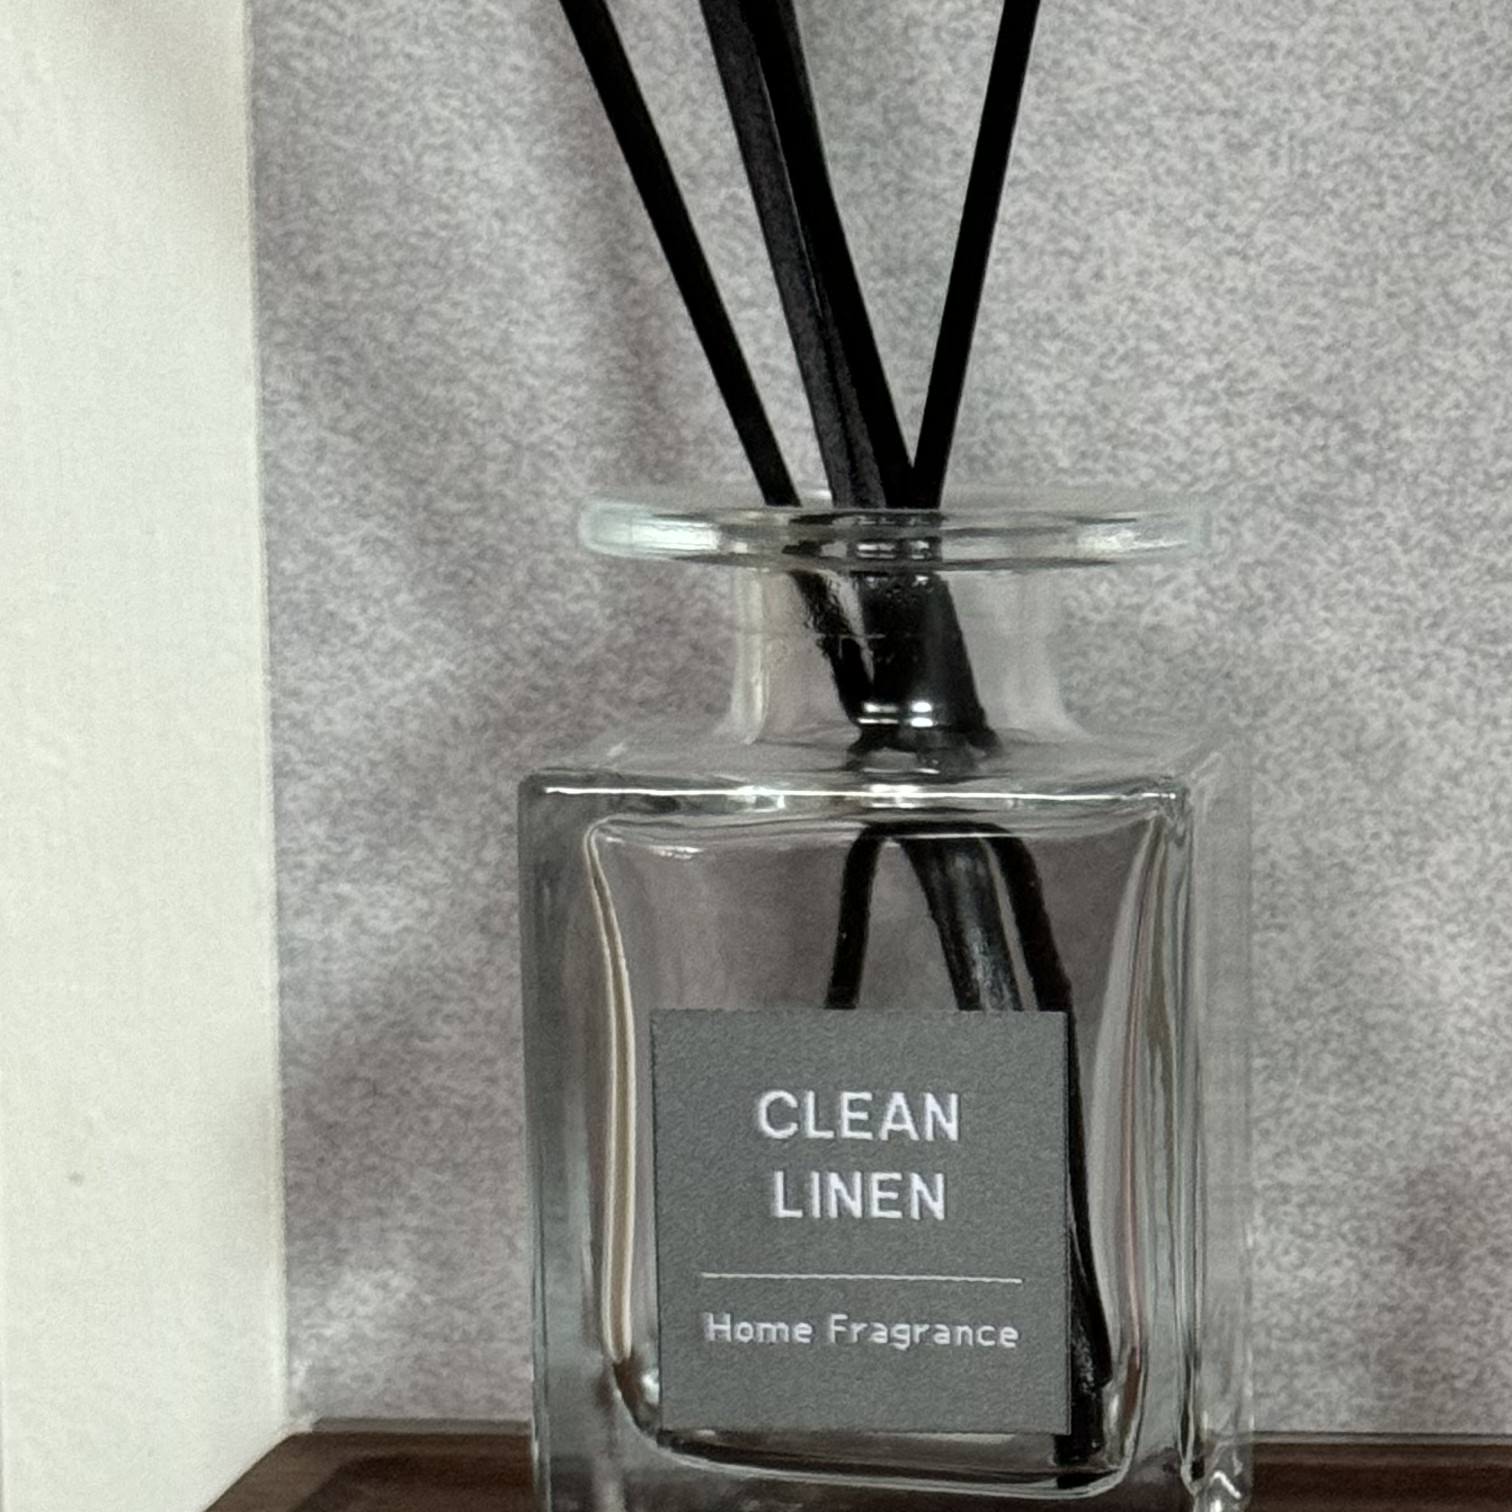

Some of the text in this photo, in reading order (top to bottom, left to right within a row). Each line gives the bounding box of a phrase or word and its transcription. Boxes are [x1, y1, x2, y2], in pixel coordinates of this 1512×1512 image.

[756, 1089, 962, 1142] CLEAN
[772, 1170, 947, 1220] LINEN
[703, 1312, 1020, 1352] Home Fragrance
